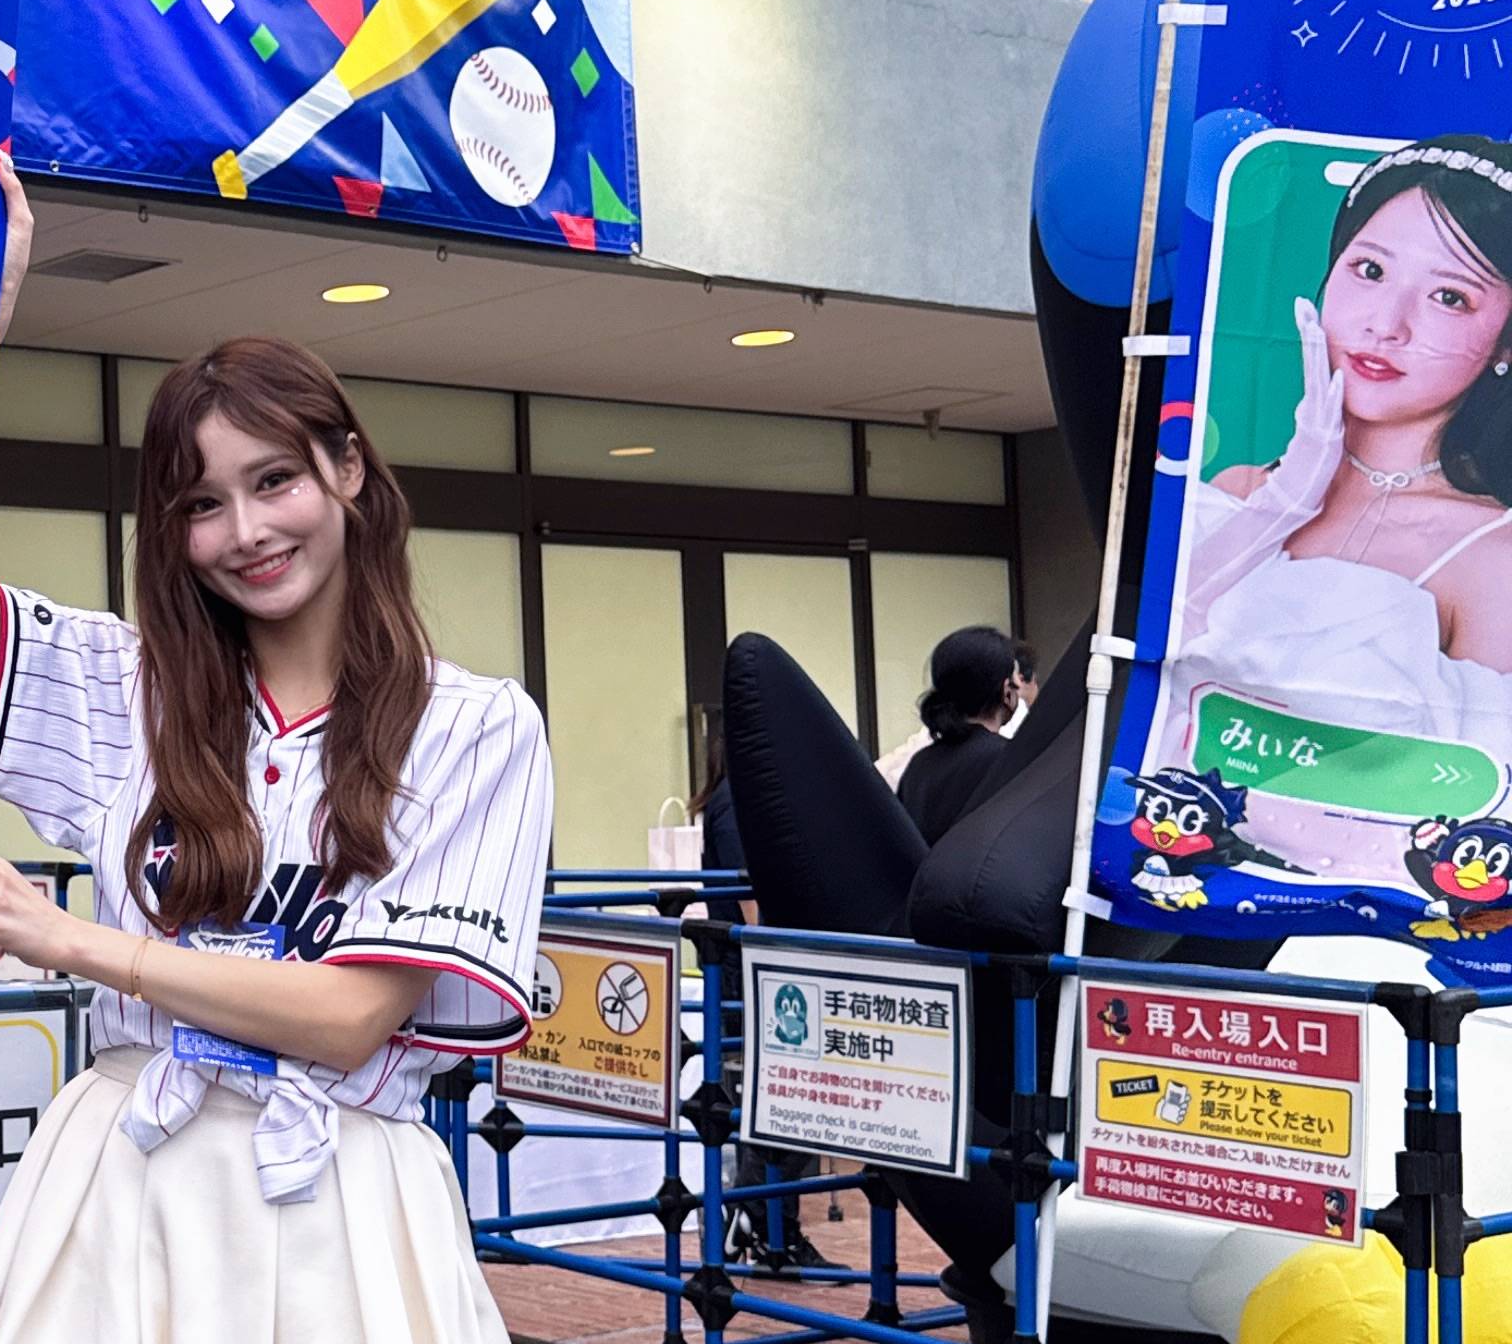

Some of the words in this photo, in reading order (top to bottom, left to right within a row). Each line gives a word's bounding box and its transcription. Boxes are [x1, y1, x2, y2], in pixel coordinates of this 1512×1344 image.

[1219, 718, 1324, 768] みいな
[1226, 757, 1259, 775] MIINA
[824, 990, 949, 1029] 手荷物検査
[1145, 1002, 1328, 1055] 再入場入口
[824, 1029, 894, 1062] 実施中
[1171, 1042, 1232, 1067] Re-entry
[1235, 1052, 1298, 1071] entrance
[594, 1057, 649, 1078] ご提供なし
[1115, 1079, 1154, 1094] TICKET
[1200, 1080, 1282, 1107] チケットを
[769, 1105, 813, 1123] Baggage
[816, 1112, 846, 1127] check
[848, 1117, 857, 1128] is
[860, 1120, 897, 1136] carried
[1200, 1100, 1335, 1134] 提示してください
[769, 1120, 799, 1135] Thank
[802, 1128, 821, 1140] you
[824, 1128, 838, 1141] for
[842, 1135, 865, 1147] your
[1200, 1120, 1232, 1135] Please
[1235, 1125, 1263, 1139] show
[1265, 1131, 1289, 1144] your
[1292, 1133, 1322, 1148] ticket
